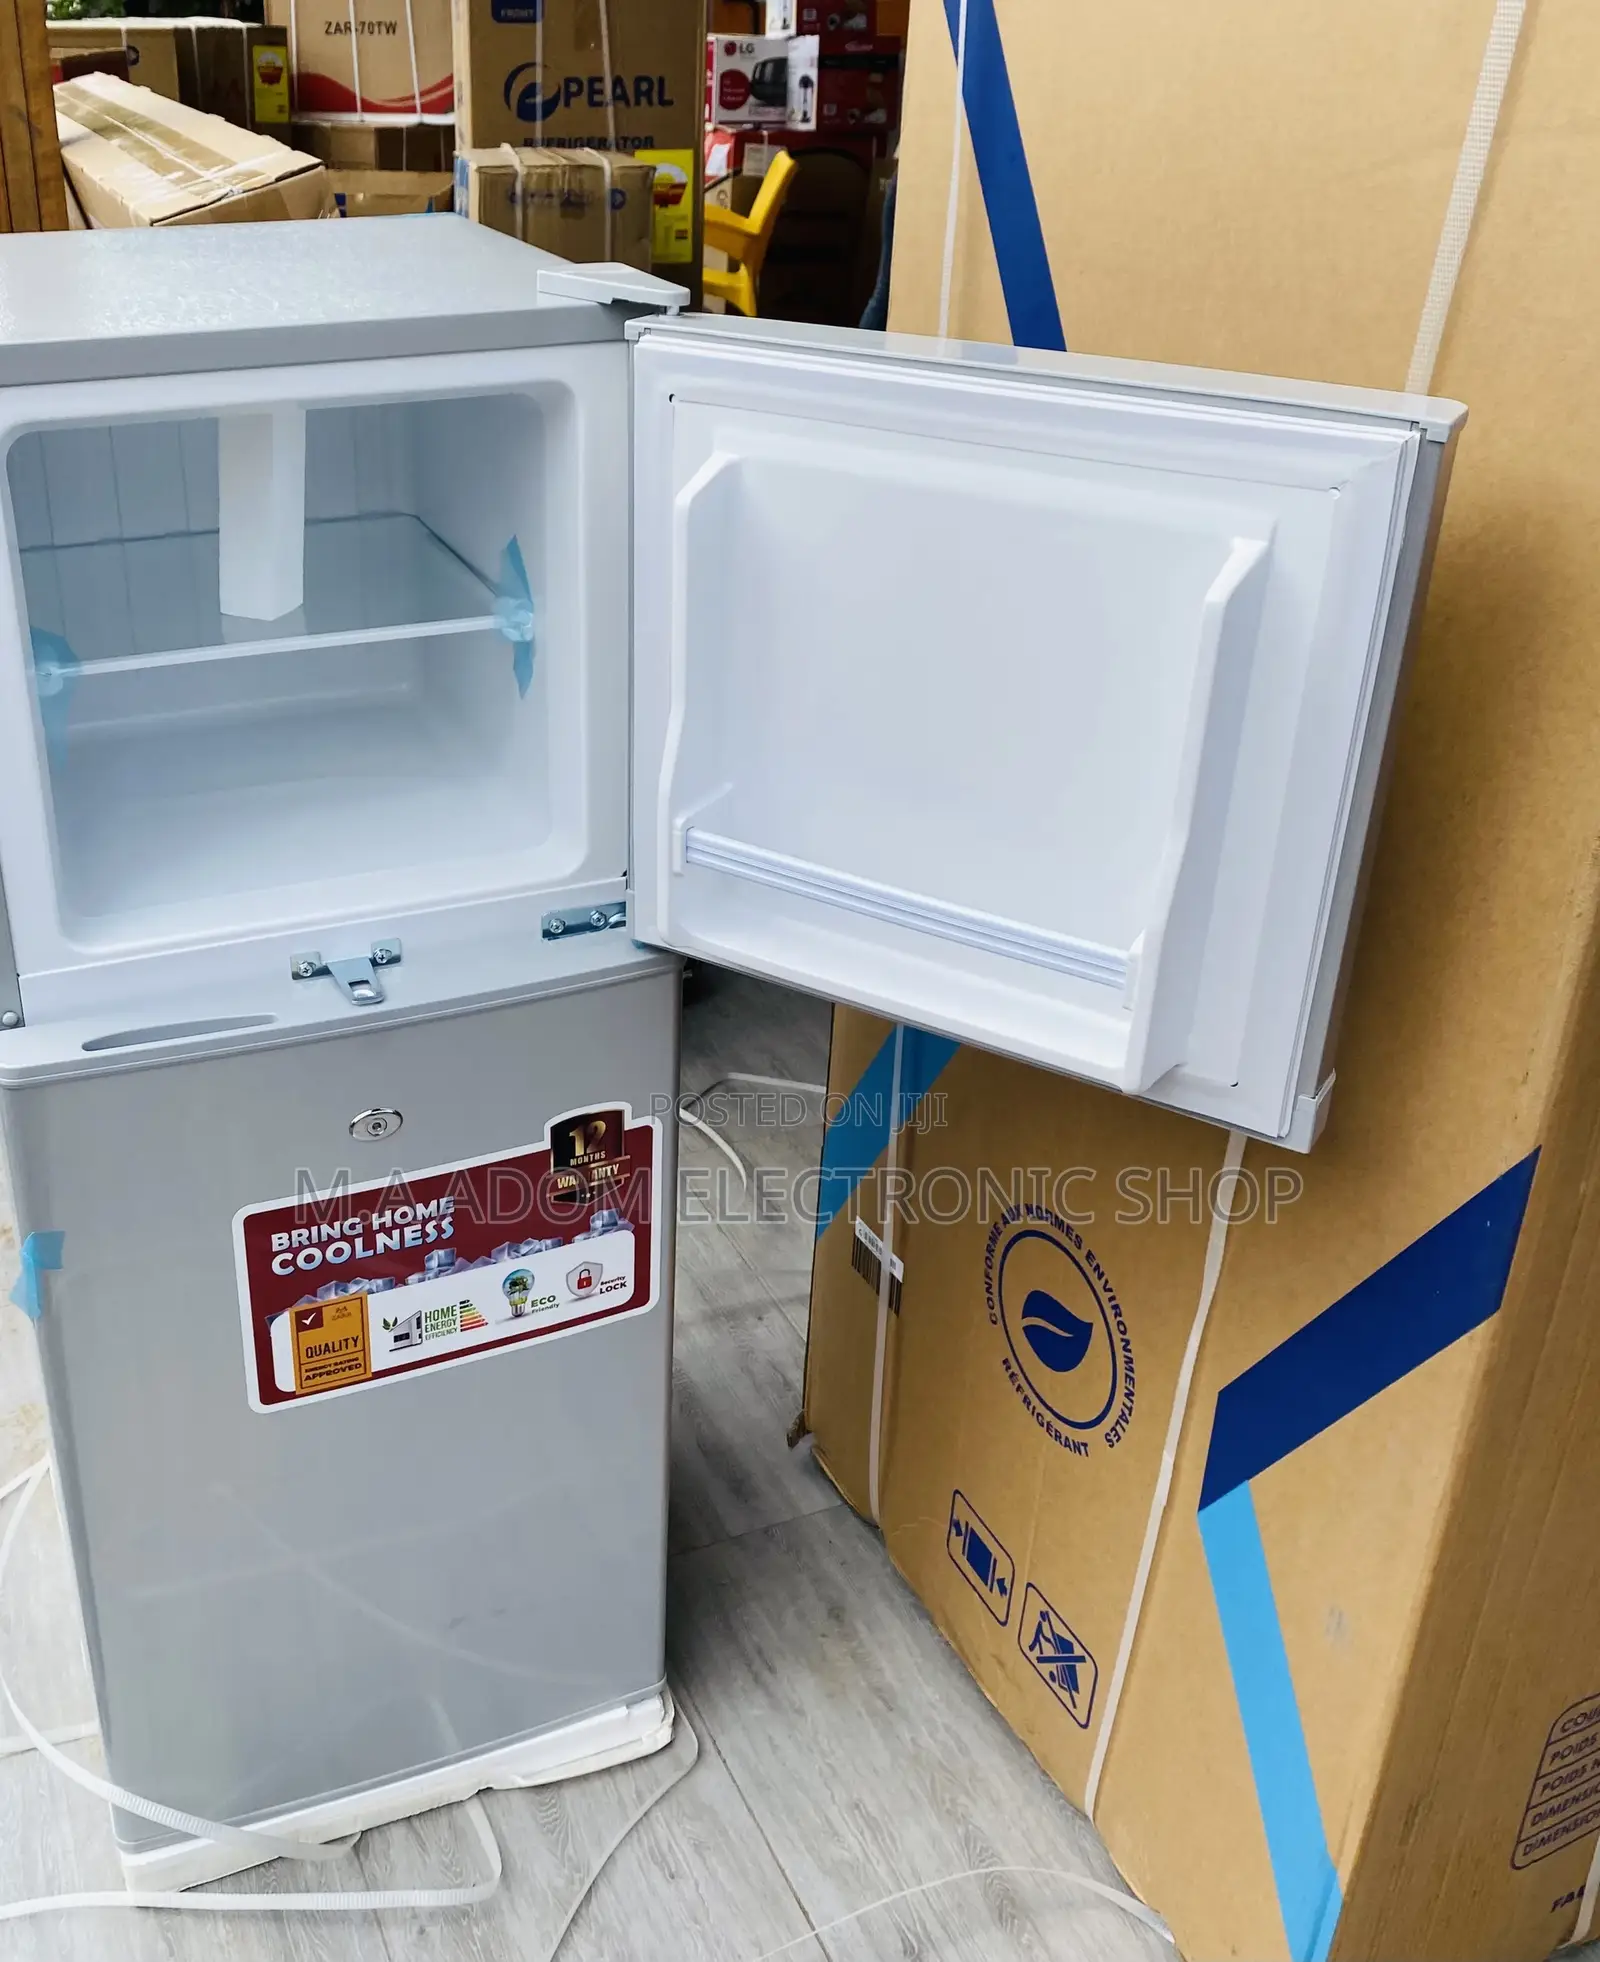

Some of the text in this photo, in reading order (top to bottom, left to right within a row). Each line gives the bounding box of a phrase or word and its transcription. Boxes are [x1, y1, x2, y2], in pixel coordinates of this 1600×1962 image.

[324, 20, 398, 36] ZAR-70TW
[739, 42, 755, 54] LG
[563, 75, 675, 109] PEARL
[523, 136, 655, 149] RFRIGERTOR
[568, 1120, 607, 1157] 12
[570, 1150, 607, 1167] MONTHS
[557, 1163, 620, 1189] WAANTY
[271, 1195, 456, 1252] BRING HOME
[271, 1217, 455, 1276] COOLNESS
[599, 1281, 628, 1295] LOCK
[600, 1275, 627, 1286] Security
[531, 1294, 557, 1308] ECO
[531, 1302, 560, 1314] Friendly
[424, 1304, 458, 1324] HOME
[424, 1317, 458, 1333] ENERGY
[424, 1327, 458, 1341] EFFICIENCY
[984, 1202, 1136, 1449] CONFORME AUX NORMES ENVIRONMENTALES
[305, 1335, 360, 1359] QUALITY
[304, 1363, 362, 1381] APPROVED
[1002, 1357, 1090, 1458] RÉFRIGÉRANT
[1549, 1732, 1599, 1766] POIDS
[1540, 1764, 1588, 1796] POIDS
